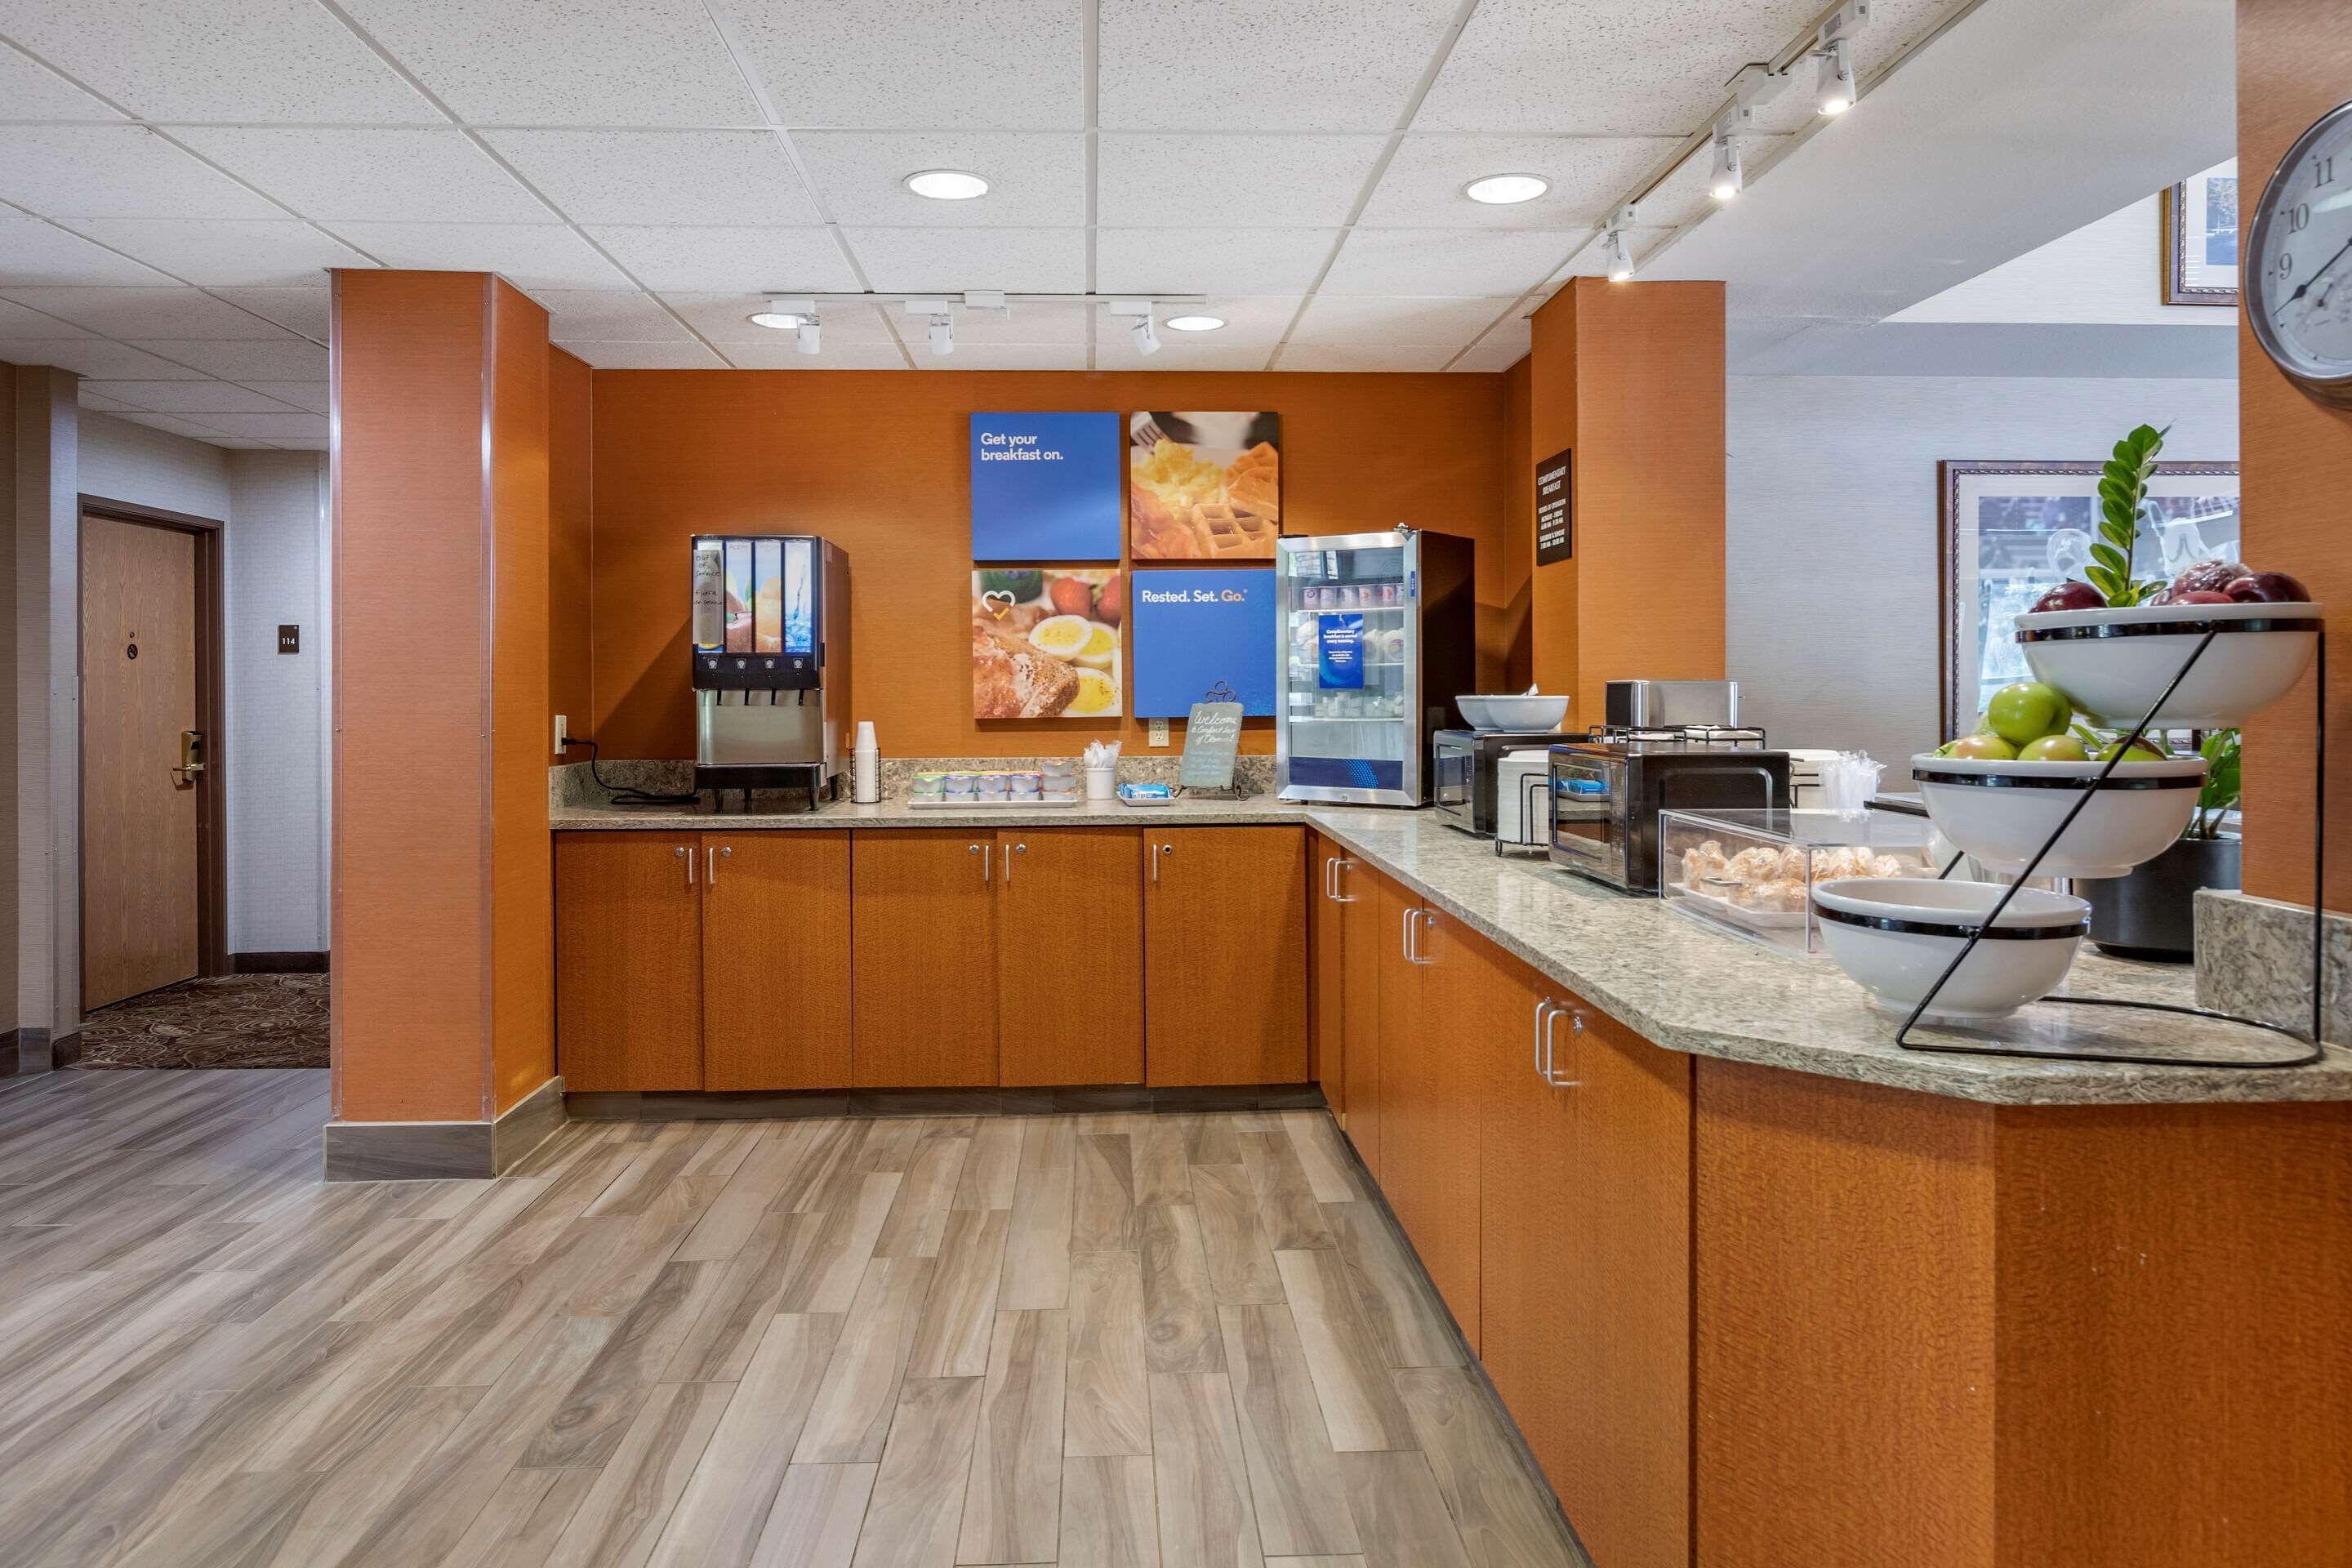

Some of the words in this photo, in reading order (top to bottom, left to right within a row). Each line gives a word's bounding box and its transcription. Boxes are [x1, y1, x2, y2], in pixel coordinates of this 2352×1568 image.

[2314, 156, 2336, 189] 11
[2287, 203, 2310, 235] 10
[2279, 253, 2293, 280] 9
[980, 432, 1006, 445] Get
[1008, 434, 1038, 448] your
[981, 448, 1041, 461] breakfast
[1043, 451, 1064, 461] on.
[1142, 590, 1191, 603] Rested.
[1193, 590, 1218, 603] Set.
[1194, 710, 1237, 725] Welcome
